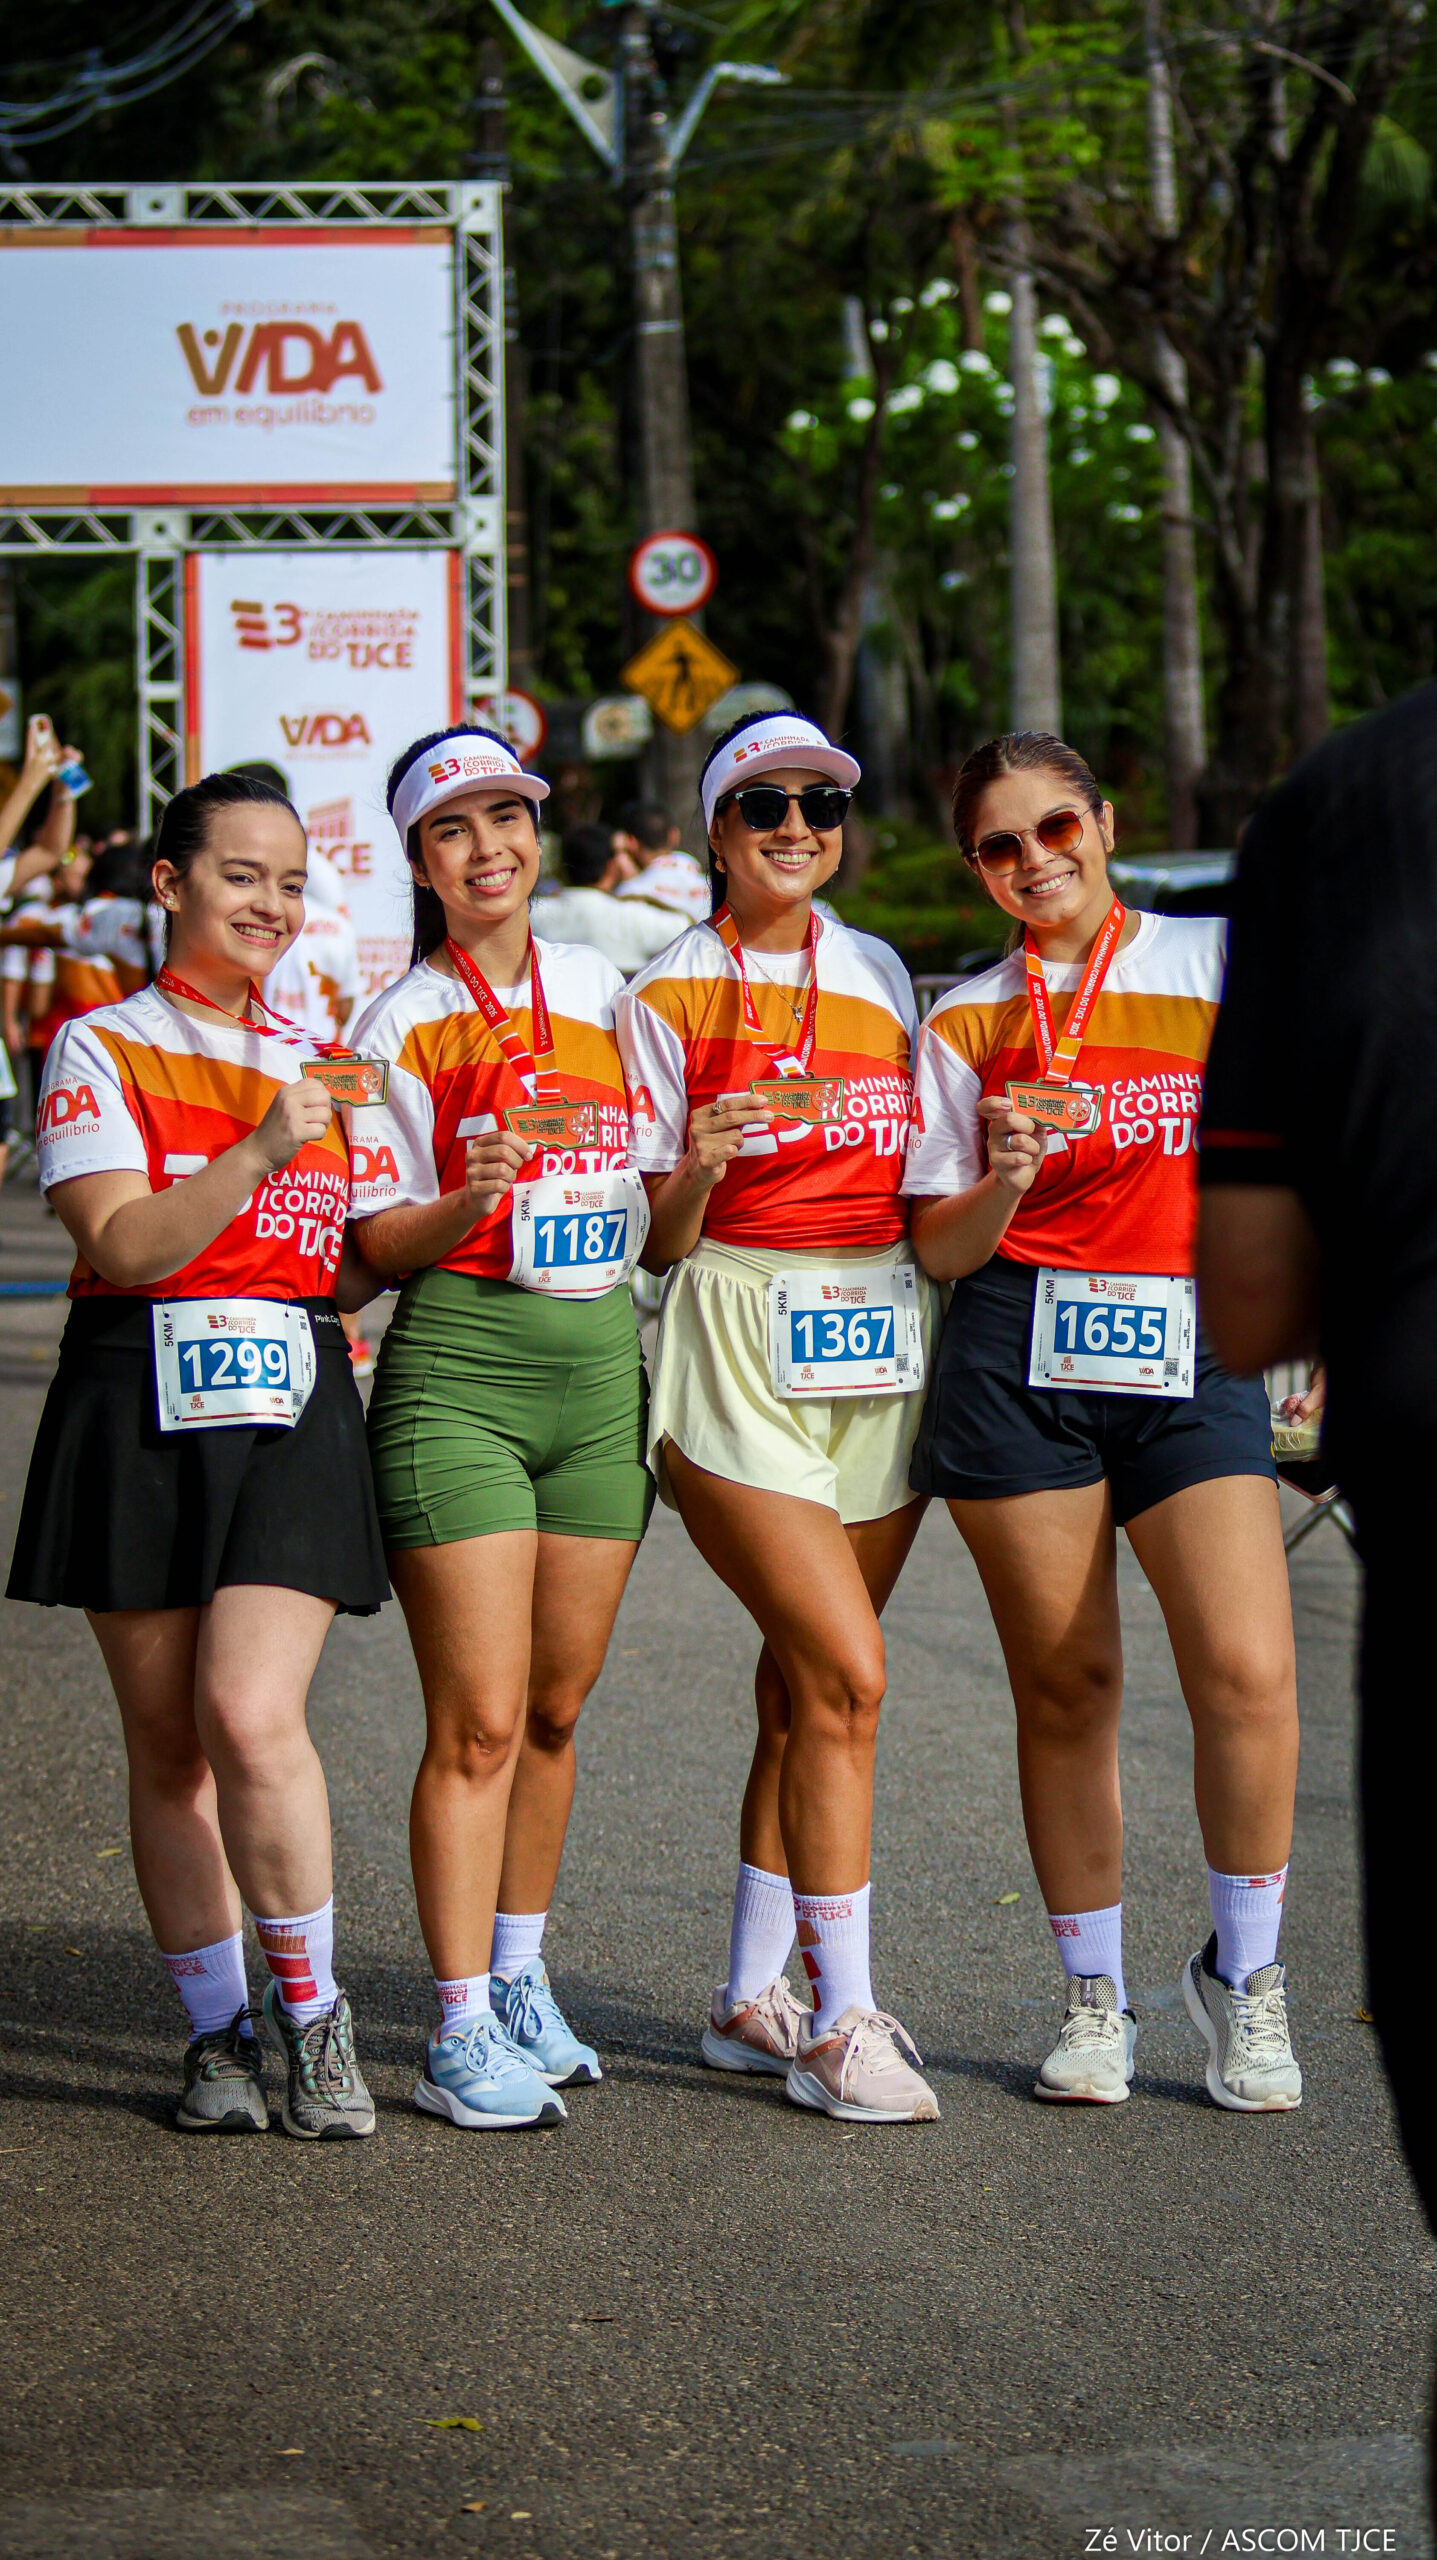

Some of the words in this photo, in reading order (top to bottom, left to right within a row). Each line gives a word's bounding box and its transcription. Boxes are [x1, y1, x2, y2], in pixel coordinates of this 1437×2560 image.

[175, 321, 384, 396] VIDA
[186, 405, 228, 427] em
[648, 552, 700, 586] 30
[308, 642, 341, 660] DO
[346, 642, 411, 668] TJCE
[279, 714, 371, 746] VIDA
[464, 767, 480, 776] DO
[468, 975, 480, 989] DO
[474, 986, 488, 1001] TJCE
[483, 1001, 498, 1017] 2026
[1034, 982, 1042, 995] 2026
[1080, 995, 1089, 1006] DO
[1038, 1010, 1046, 1020] DO
[1075, 1005, 1086, 1020] TJCE
[1069, 1022, 1080, 1036] 2026
[1112, 1073, 1202, 1096] CAMINH
[1109, 1092, 1199, 1122] /CORR
[824, 1121, 865, 1152] DO
[1111, 1118, 1154, 1149] DO
[542, 1150, 576, 1177] DO
[267, 1169, 349, 1202] CAMINHA
[521, 1199, 530, 1221] 5KM
[589, 1200, 603, 1208] TJCE
[256, 1212, 295, 1240] DO
[538, 1213, 626, 1263] 1187
[778, 1291, 787, 1315] 5KM
[850, 1296, 865, 1304] TJCE
[1045, 1279, 1055, 1304] 5KM
[1117, 1292, 1135, 1300] TJCE
[164, 1322, 173, 1347] 5KM
[795, 1310, 892, 1358] 1367
[1060, 1305, 1162, 1355] 1655
[182, 1341, 288, 1388] 1299
